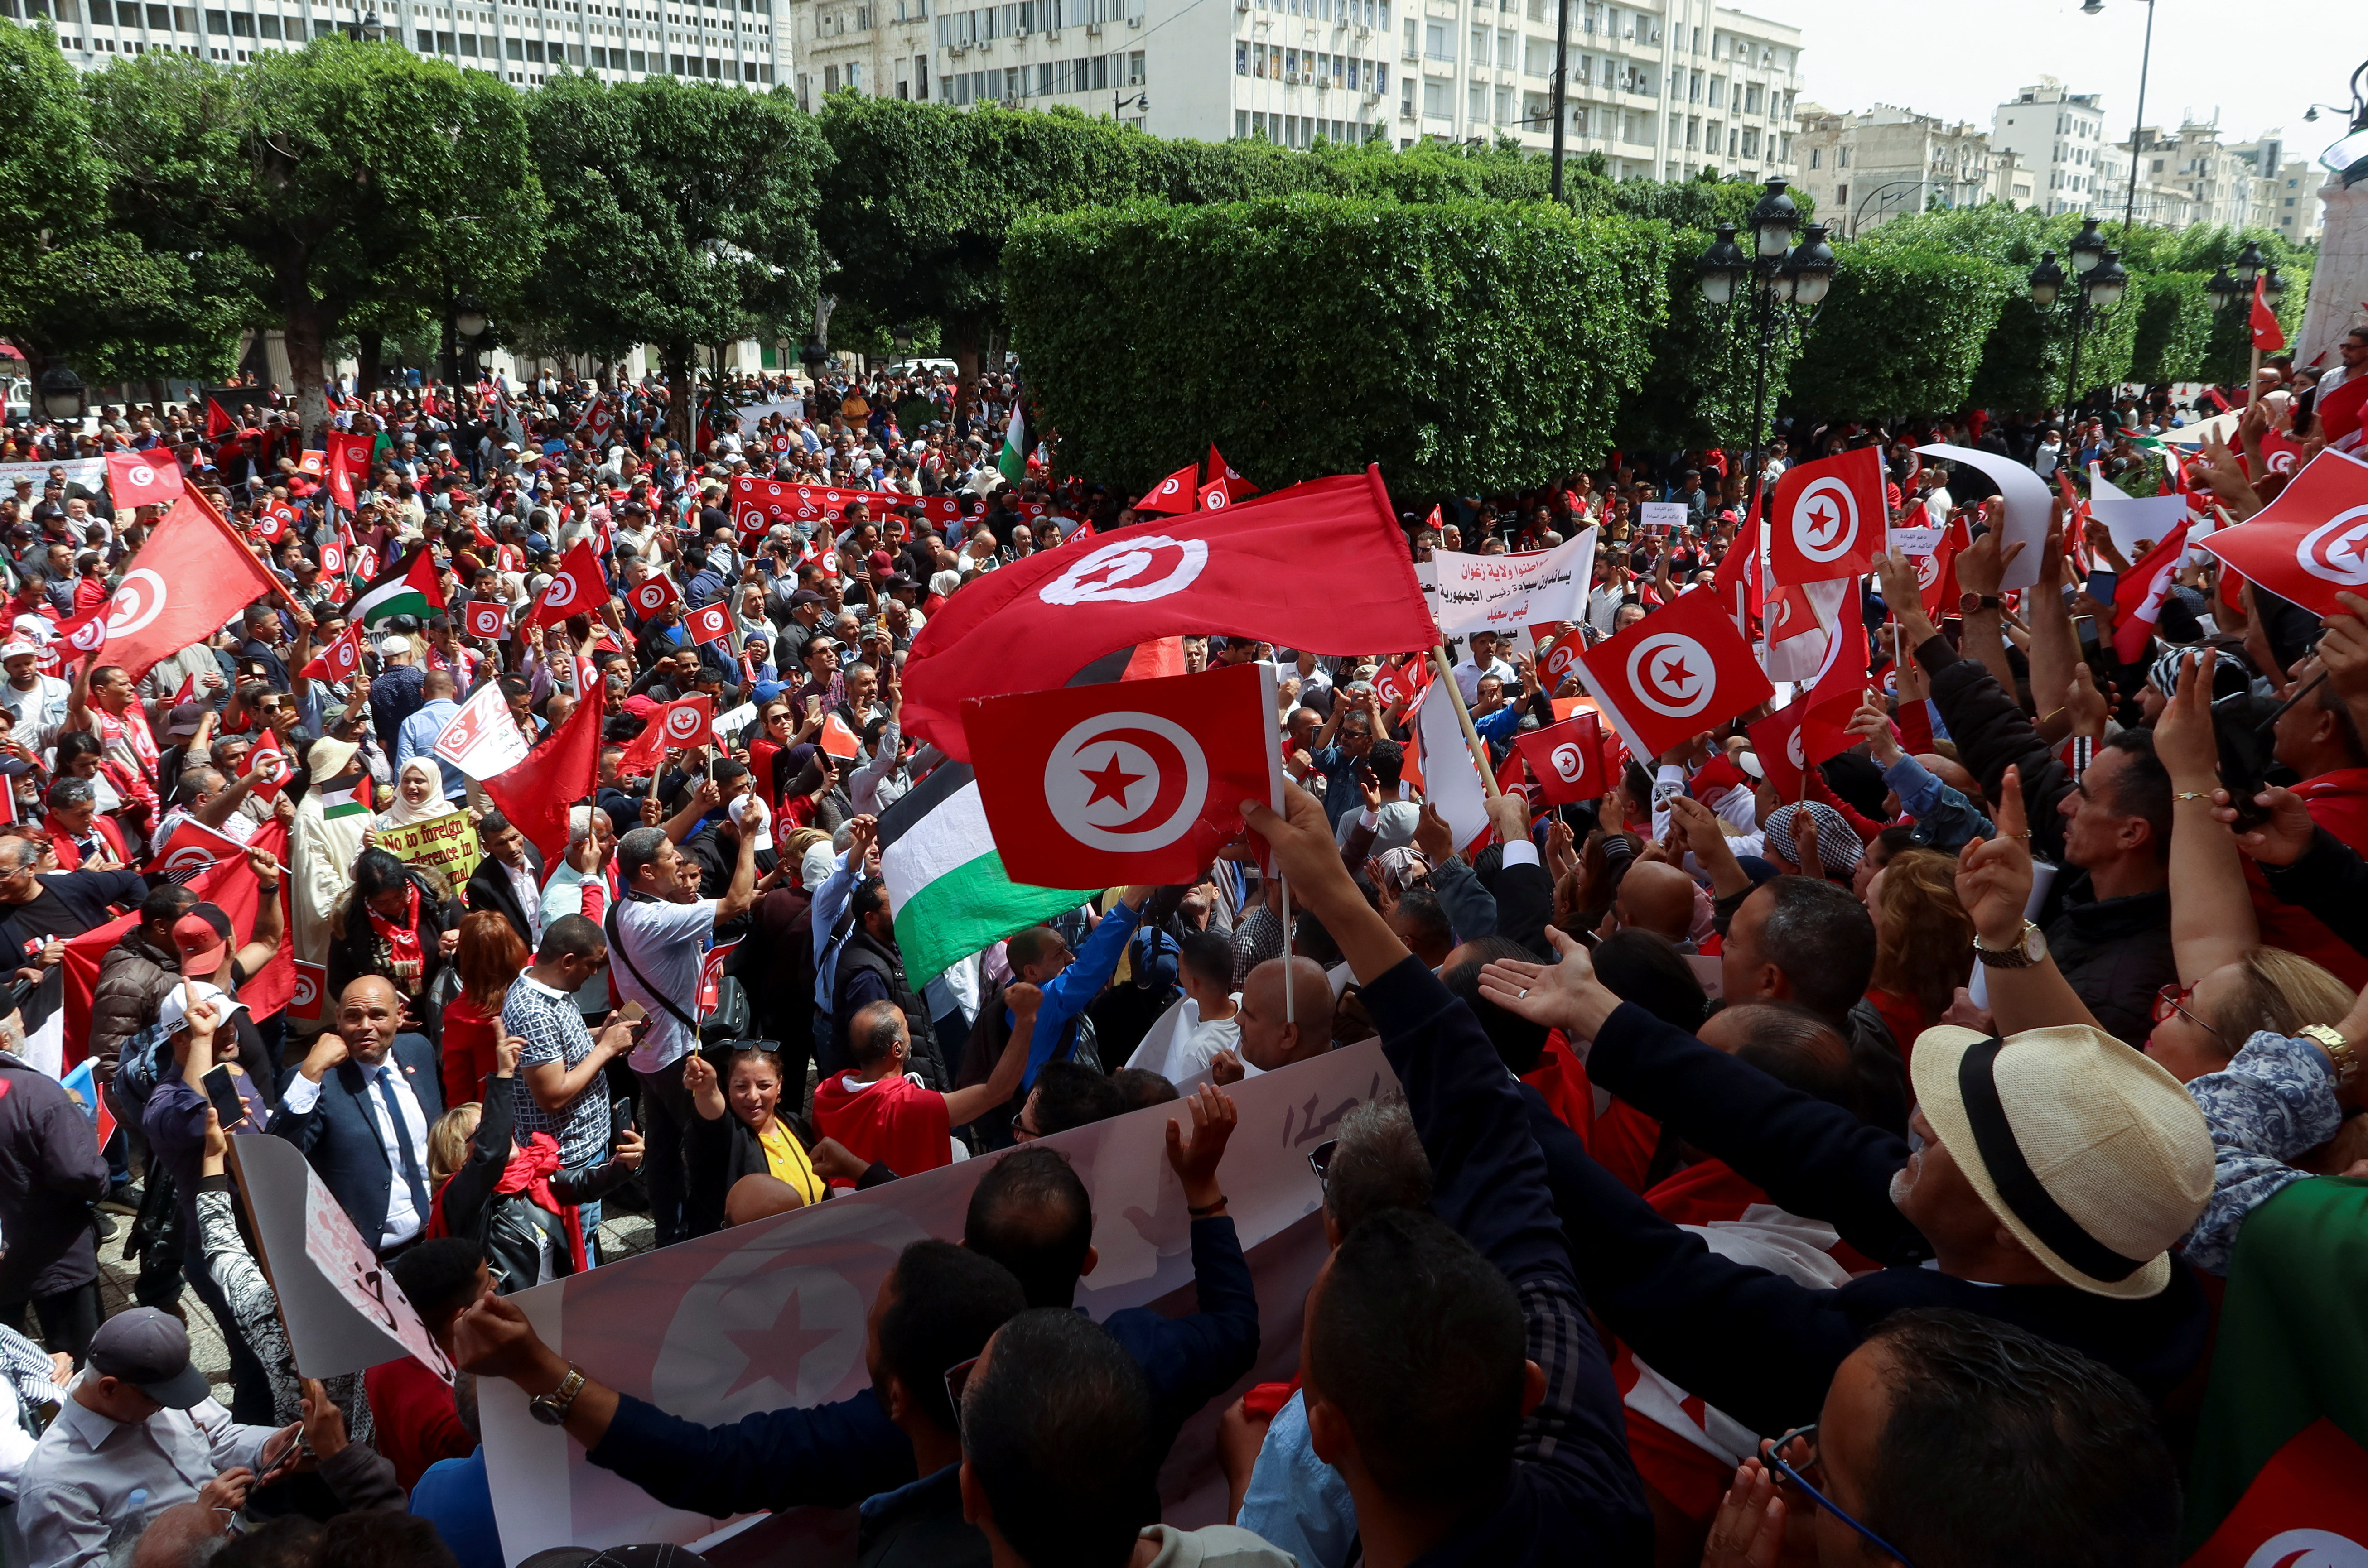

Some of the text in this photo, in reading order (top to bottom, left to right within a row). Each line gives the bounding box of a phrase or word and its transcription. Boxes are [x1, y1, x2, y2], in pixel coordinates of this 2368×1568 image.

[1461, 558, 1549, 582] مواطنوا ولاية زغوان
[1538, 568, 1572, 591] يساندون
[1439, 583, 1482, 606] الجمهورية
[1486, 587, 1511, 603] رئيس
[1511, 580, 1538, 593] سيادة
[1509, 600, 1529, 622] قيس
[383, 819, 465, 852] No to foreign
[460, 839, 473, 857] in
